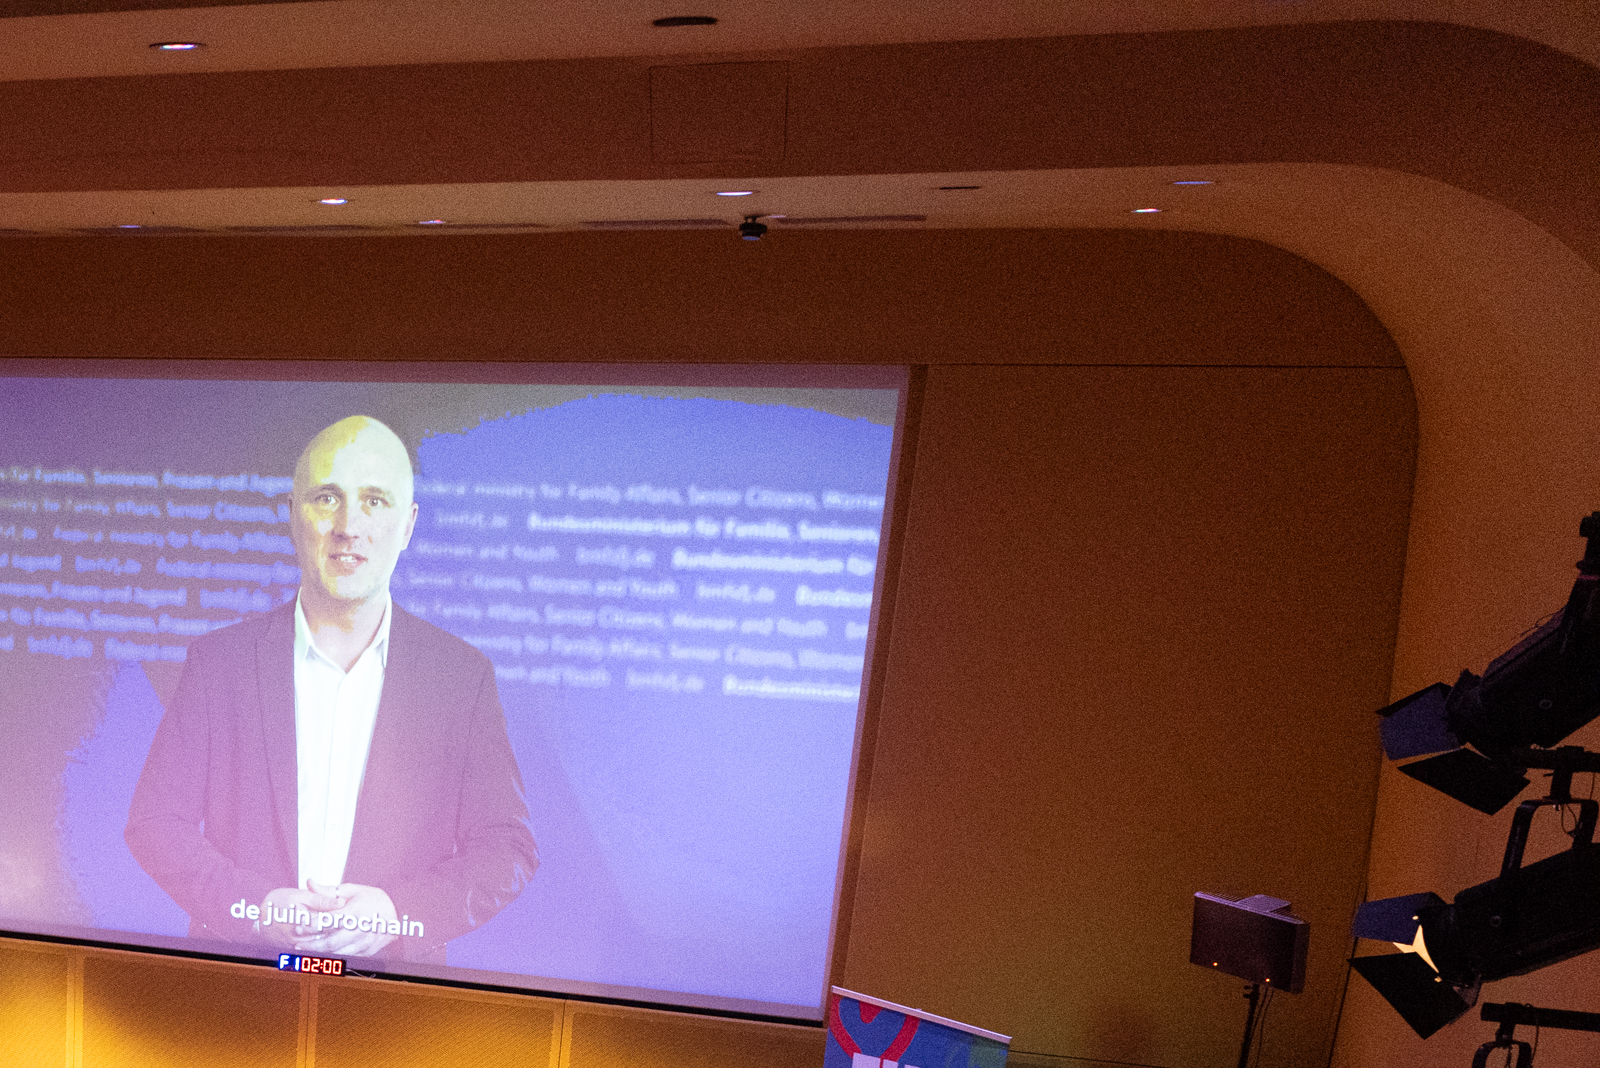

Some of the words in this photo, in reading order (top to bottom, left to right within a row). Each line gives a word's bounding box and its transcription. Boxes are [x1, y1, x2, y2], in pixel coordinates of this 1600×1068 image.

[230, 899, 261, 919] de
[263, 902, 310, 926] juin
[317, 910, 425, 937] prochain
